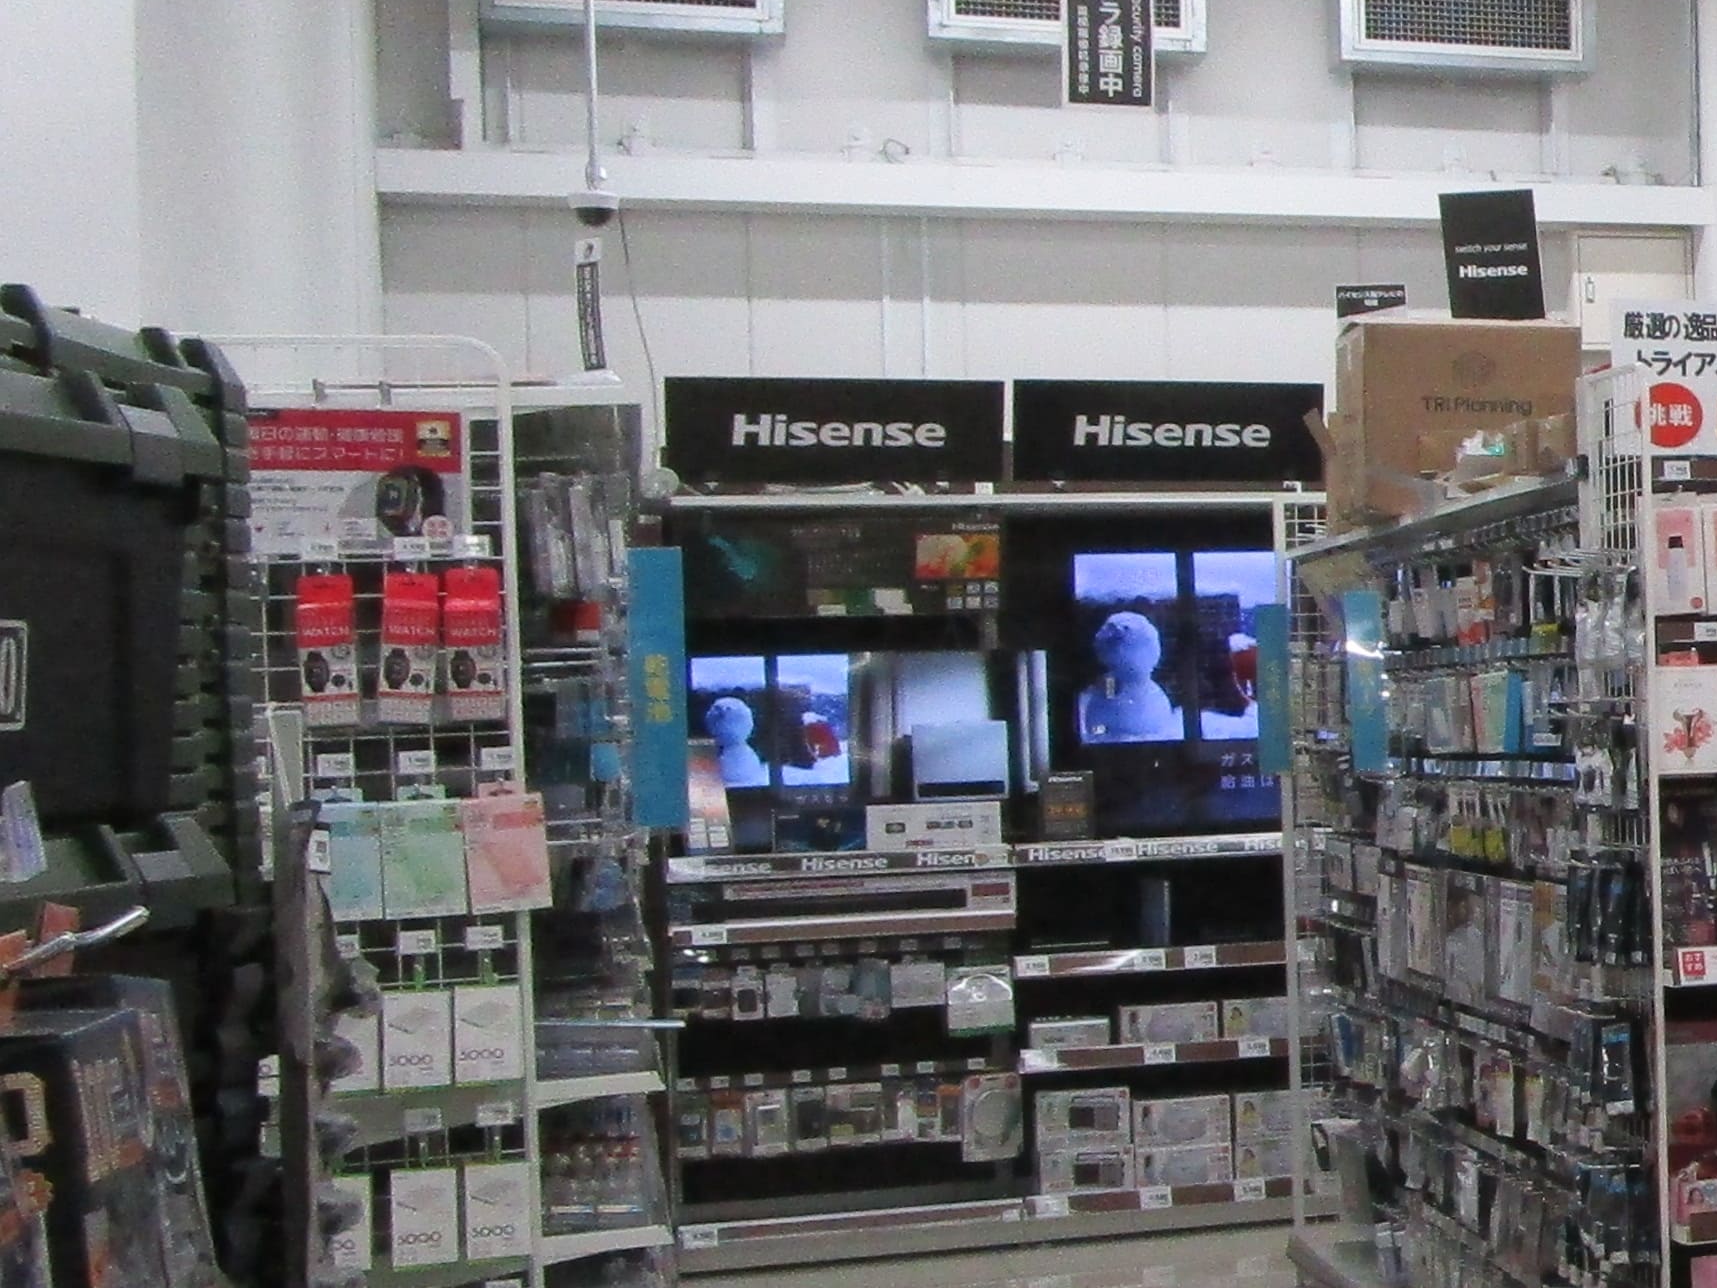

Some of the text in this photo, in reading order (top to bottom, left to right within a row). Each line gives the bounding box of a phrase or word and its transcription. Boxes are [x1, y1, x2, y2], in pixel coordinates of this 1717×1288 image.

[1459, 264, 1528, 278] Hisense
[732, 413, 946, 448] Hisense
[1073, 415, 1271, 448] Hisense
[800, 856, 888, 872] Hisense
[916, 852, 976, 867] Hisen
[703, 862, 772, 876] sense
